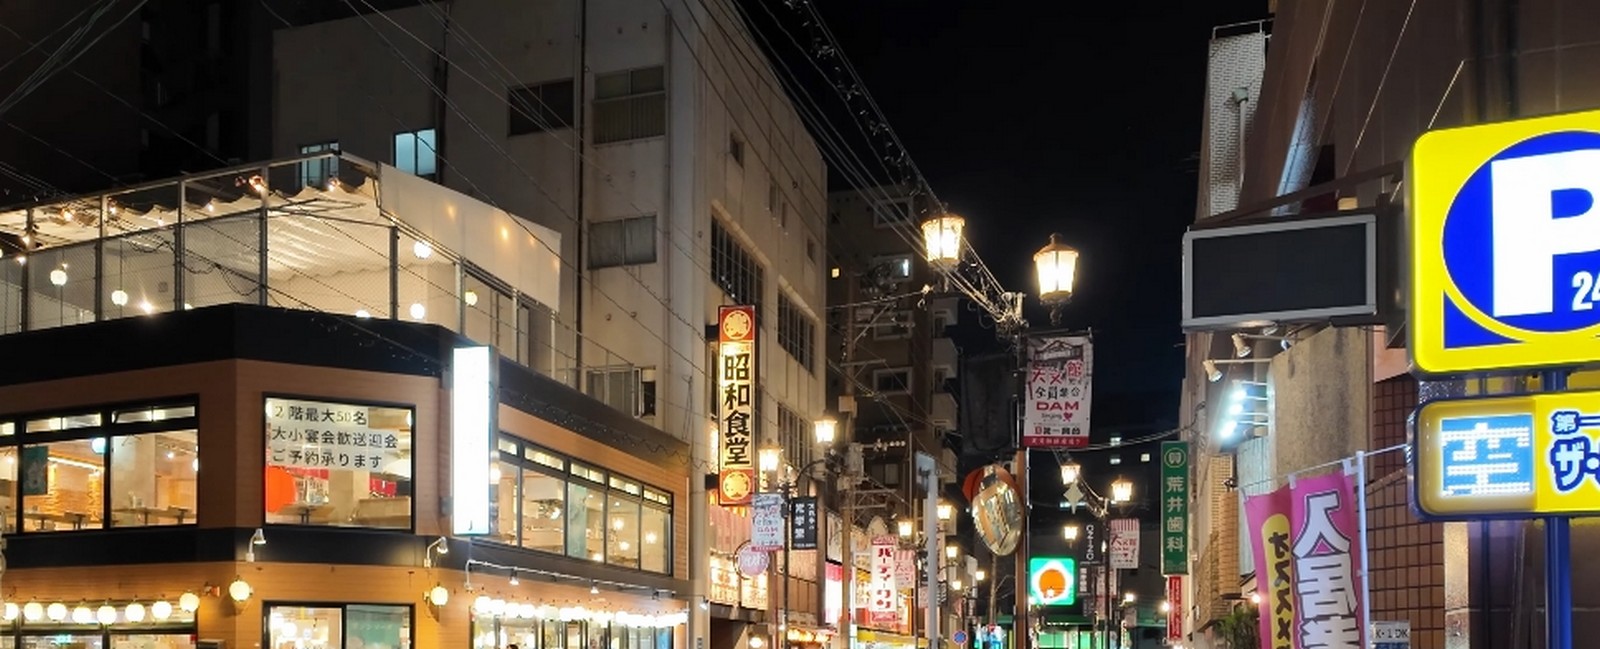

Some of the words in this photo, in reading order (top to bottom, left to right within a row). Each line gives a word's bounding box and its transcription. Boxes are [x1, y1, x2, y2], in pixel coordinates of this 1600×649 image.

[274, 405, 368, 426] 2階最大50名
[724, 353, 751, 467] 昭和食堂
[1036, 401, 1080, 411] DAM
[271, 426, 399, 449] 大小宴会歓送迎会
[272, 449, 383, 469] ご予約承ります
[1166, 475, 1185, 553] 荒井歯科
